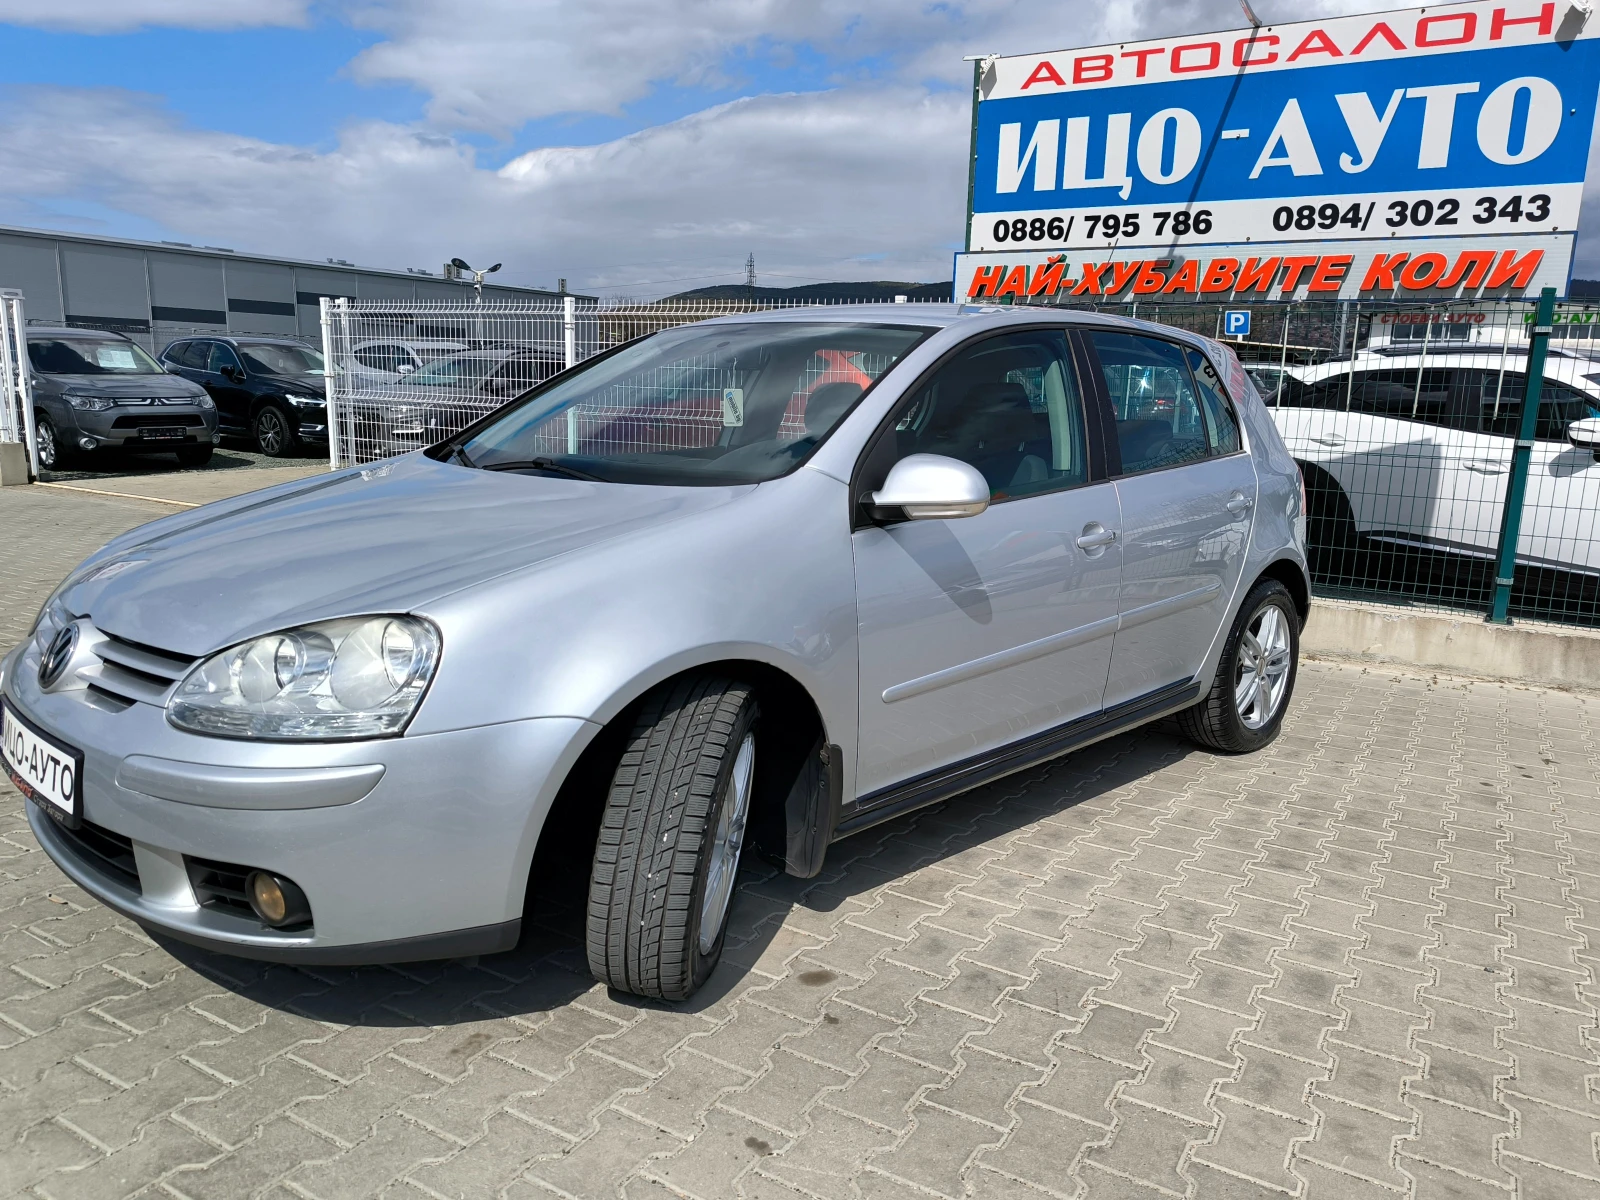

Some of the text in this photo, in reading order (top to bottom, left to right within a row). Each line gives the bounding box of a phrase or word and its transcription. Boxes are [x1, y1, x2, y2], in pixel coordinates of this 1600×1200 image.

[1021, 2, 1555, 90] АВТОСАЛОН
[996, 76, 1563, 200] ИЦО-АУТО
[993, 194, 1551, 242] 0886/ 795 786 0894/ 302 343
[967, 249, 1545, 298] НАЙ-ХУБАВИТЕ КОЛИ
[1230, 314, 1245, 332] P
[4, 715, 73, 802] ИЦО-АУТО
